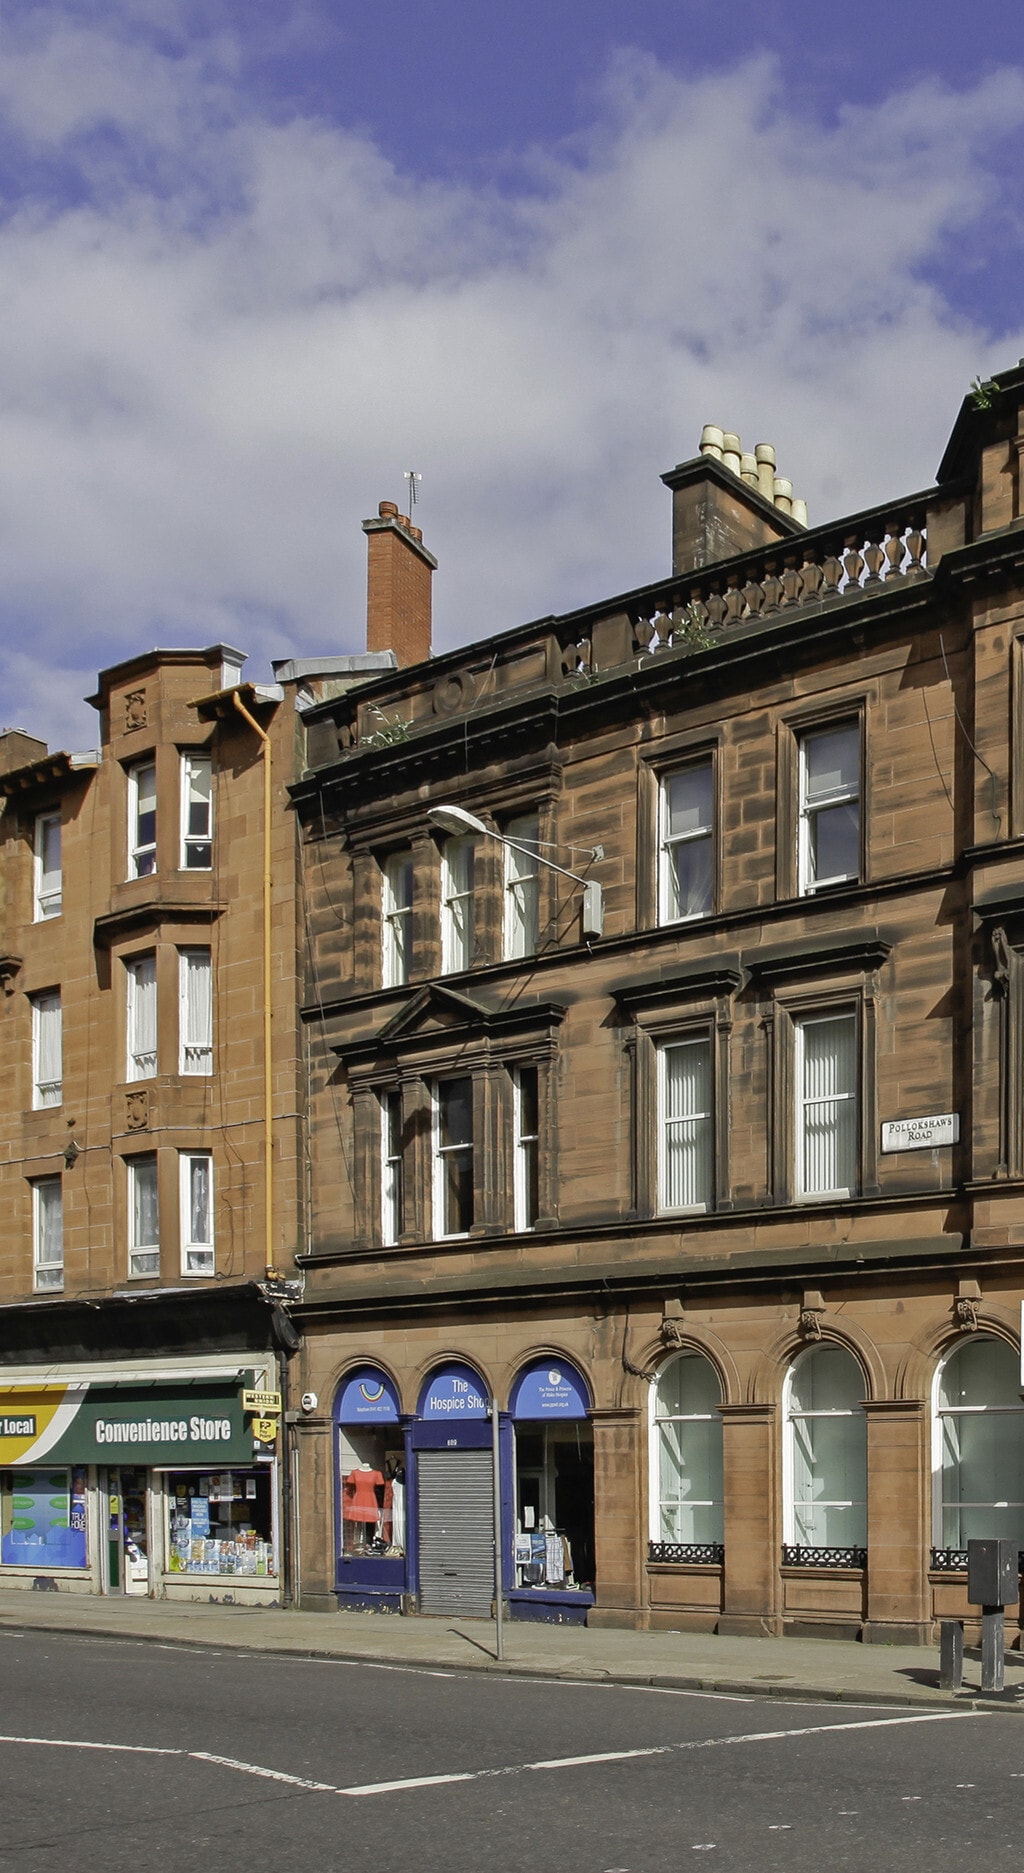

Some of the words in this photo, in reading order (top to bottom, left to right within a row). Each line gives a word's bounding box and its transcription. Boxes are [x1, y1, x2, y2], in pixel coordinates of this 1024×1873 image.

[889, 1118, 952, 1133] POLLOKSHAWS
[908, 1131, 933, 1141] ROAD
[452, 1379, 469, 1393] The
[430, 1396, 465, 1412] Hospice
[4, 1418, 34, 1435] Local
[95, 1418, 188, 1443] Convenience
[190, 1416, 231, 1441] Store
